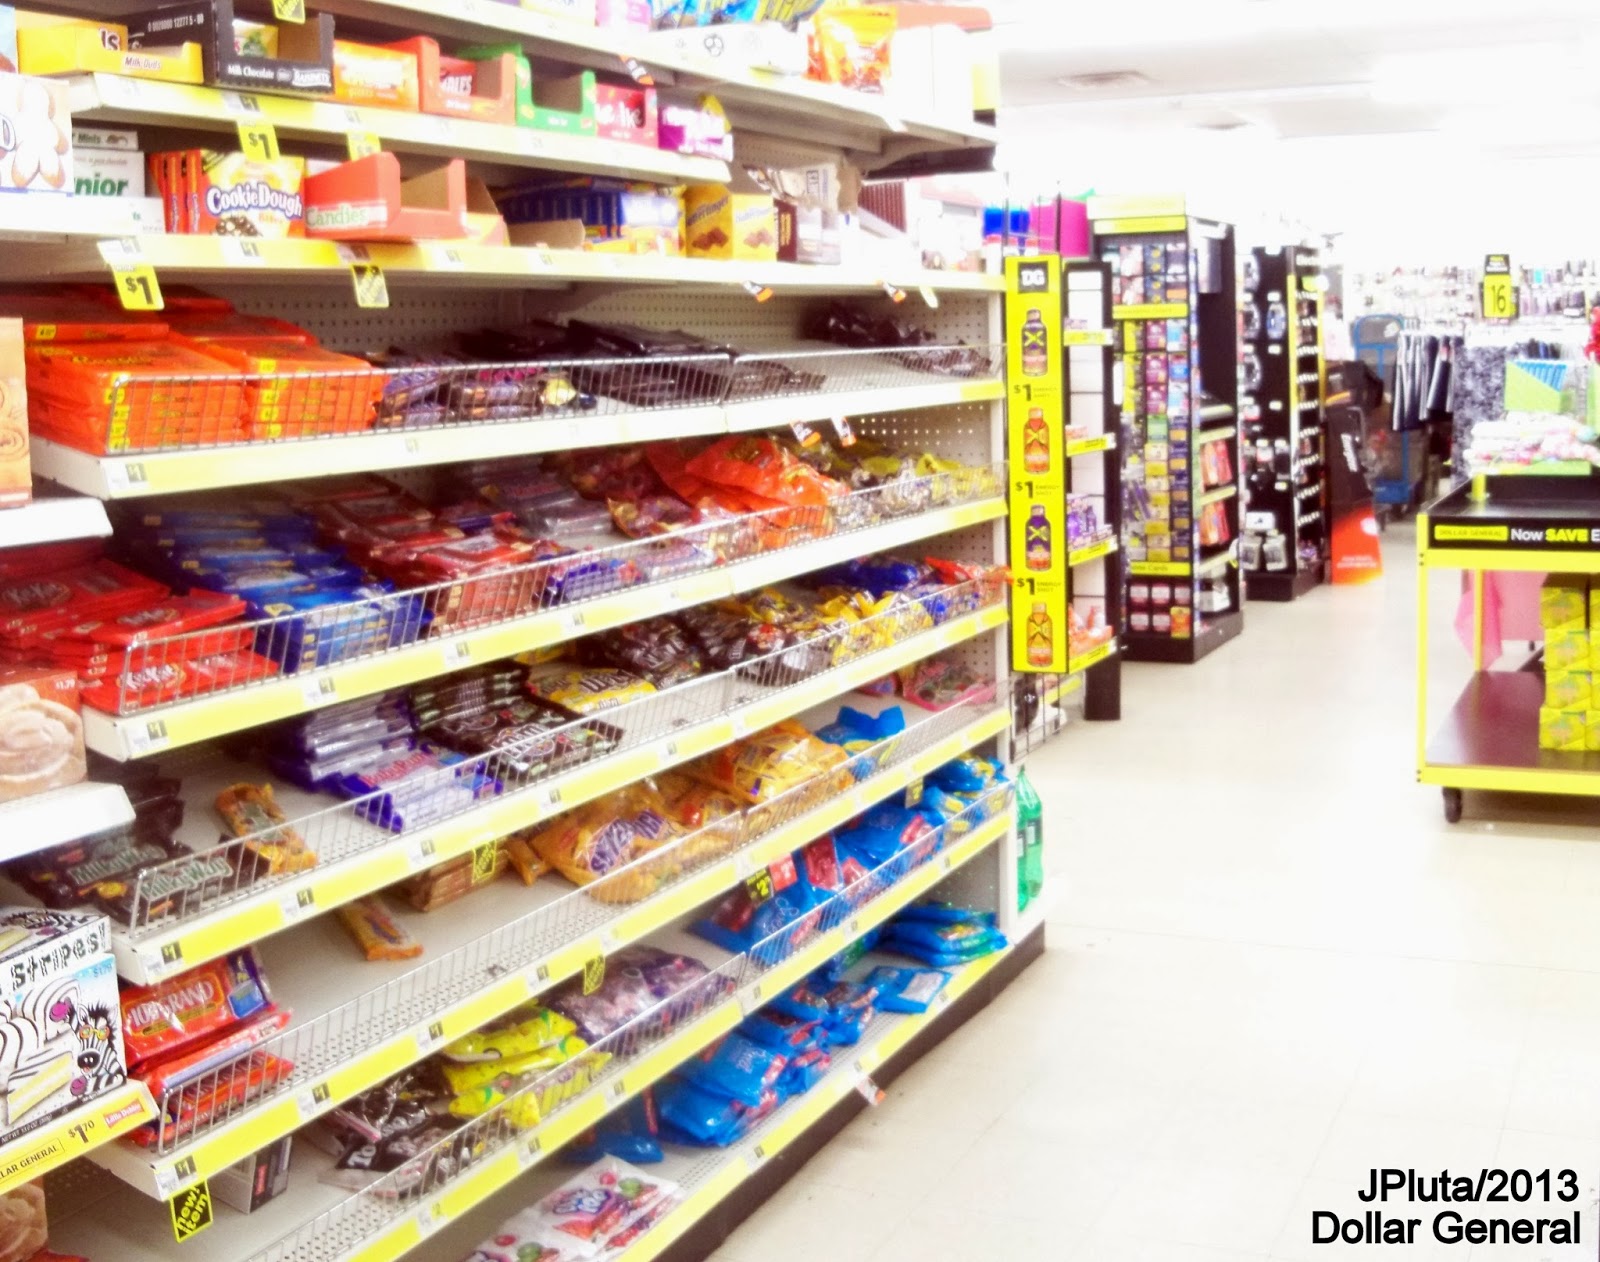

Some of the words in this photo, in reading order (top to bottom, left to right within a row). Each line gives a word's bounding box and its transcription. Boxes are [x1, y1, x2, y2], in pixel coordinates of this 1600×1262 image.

[243, 66, 274, 79] Chocolate
[248, 132, 271, 160] $1
[74, 172, 128, 196] nior
[206, 182, 259, 215] Cookie
[257, 182, 303, 219] Dough
[305, 204, 368, 228] Candies
[1021, 270, 1045, 286] DG
[125, 276, 153, 305] $1
[1491, 284, 1506, 313] 16
[1014, 384, 1031, 401] $1
[1015, 481, 1033, 499] $1
[1510, 528, 1543, 541] Now
[1545, 528, 1589, 542] SAVE
[1017, 577, 1035, 596] $1
[0, 1164, 19, 1180] LAR
[20, 1145, 58, 1168] GENERAL
